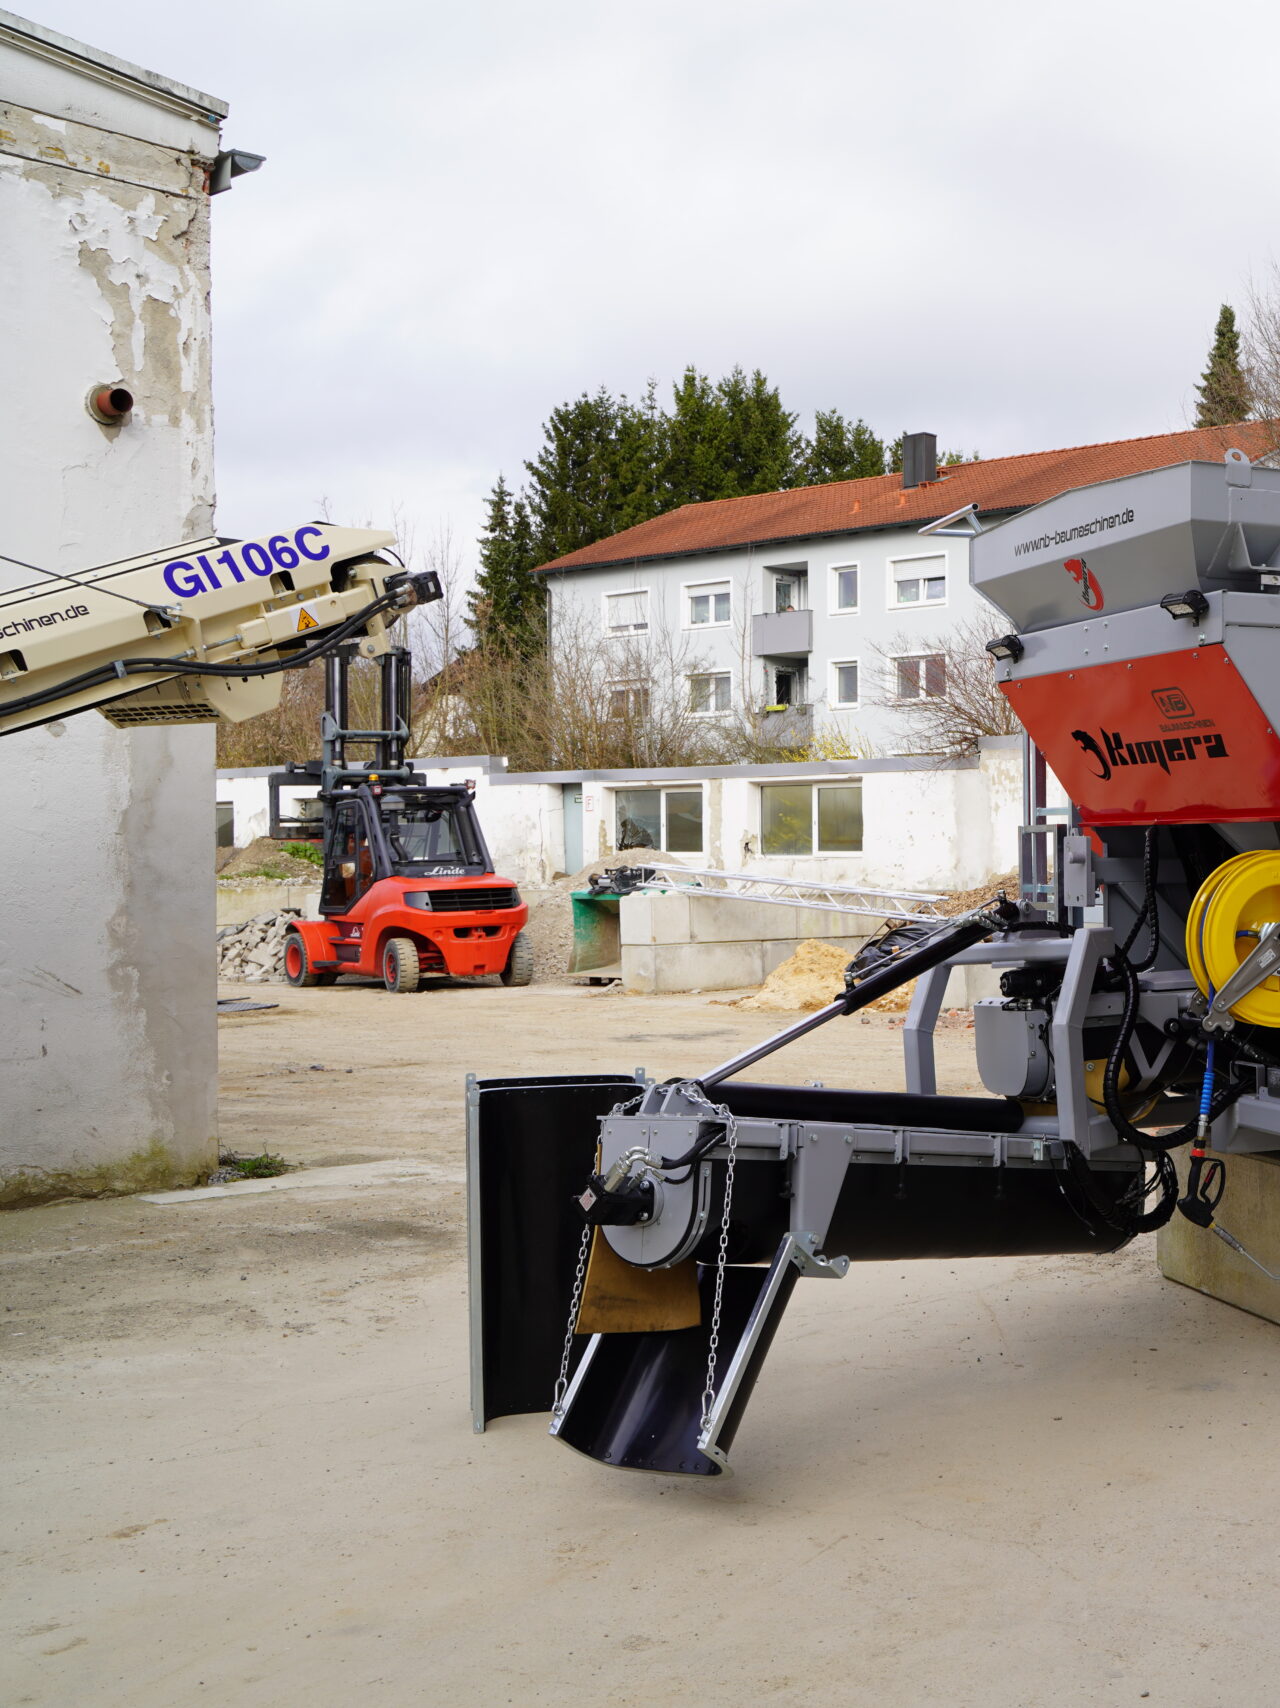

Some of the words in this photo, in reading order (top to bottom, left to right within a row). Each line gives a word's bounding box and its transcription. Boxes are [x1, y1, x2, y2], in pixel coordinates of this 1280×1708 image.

[1014, 507, 1135, 557] www.nb-baumaschinen.de
[163, 526, 330, 598] GI106C
[424, 866, 465, 876] Linde
